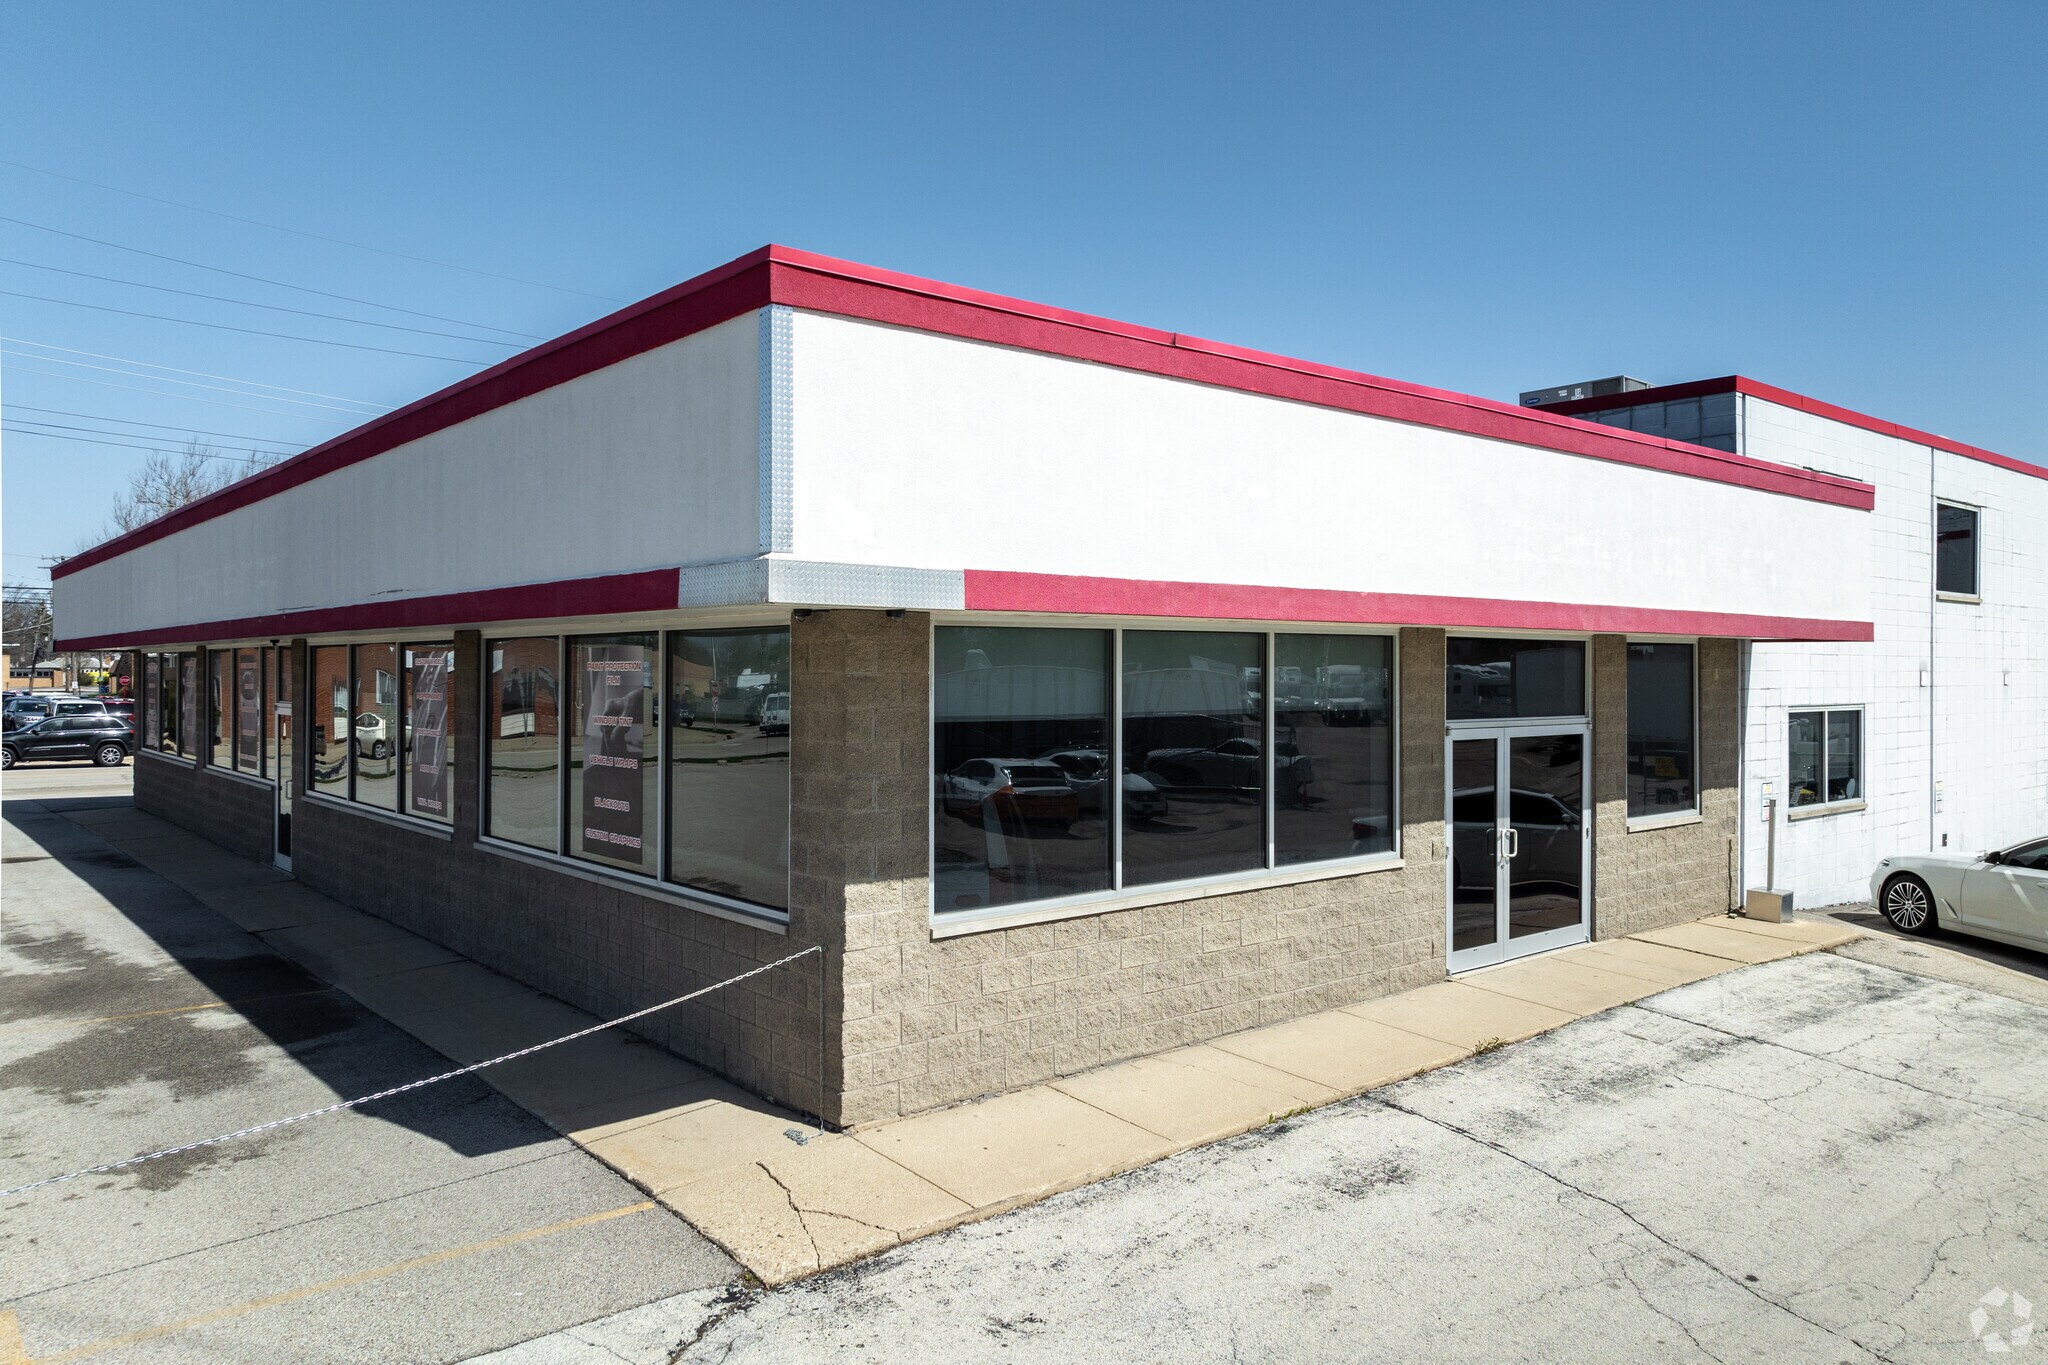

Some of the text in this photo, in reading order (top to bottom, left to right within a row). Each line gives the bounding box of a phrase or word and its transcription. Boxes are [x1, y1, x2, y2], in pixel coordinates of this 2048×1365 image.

[587, 661, 641, 671] PAINT PROTECTION
[606, 675, 620, 685] FILM
[592, 715, 633, 726] WINDOW TINT
[589, 754, 638, 769] VEHICLE WRAPS
[594, 797, 630, 812] BLACKOUTS
[585, 828, 641, 849] CUSTOM GRAPHICS
